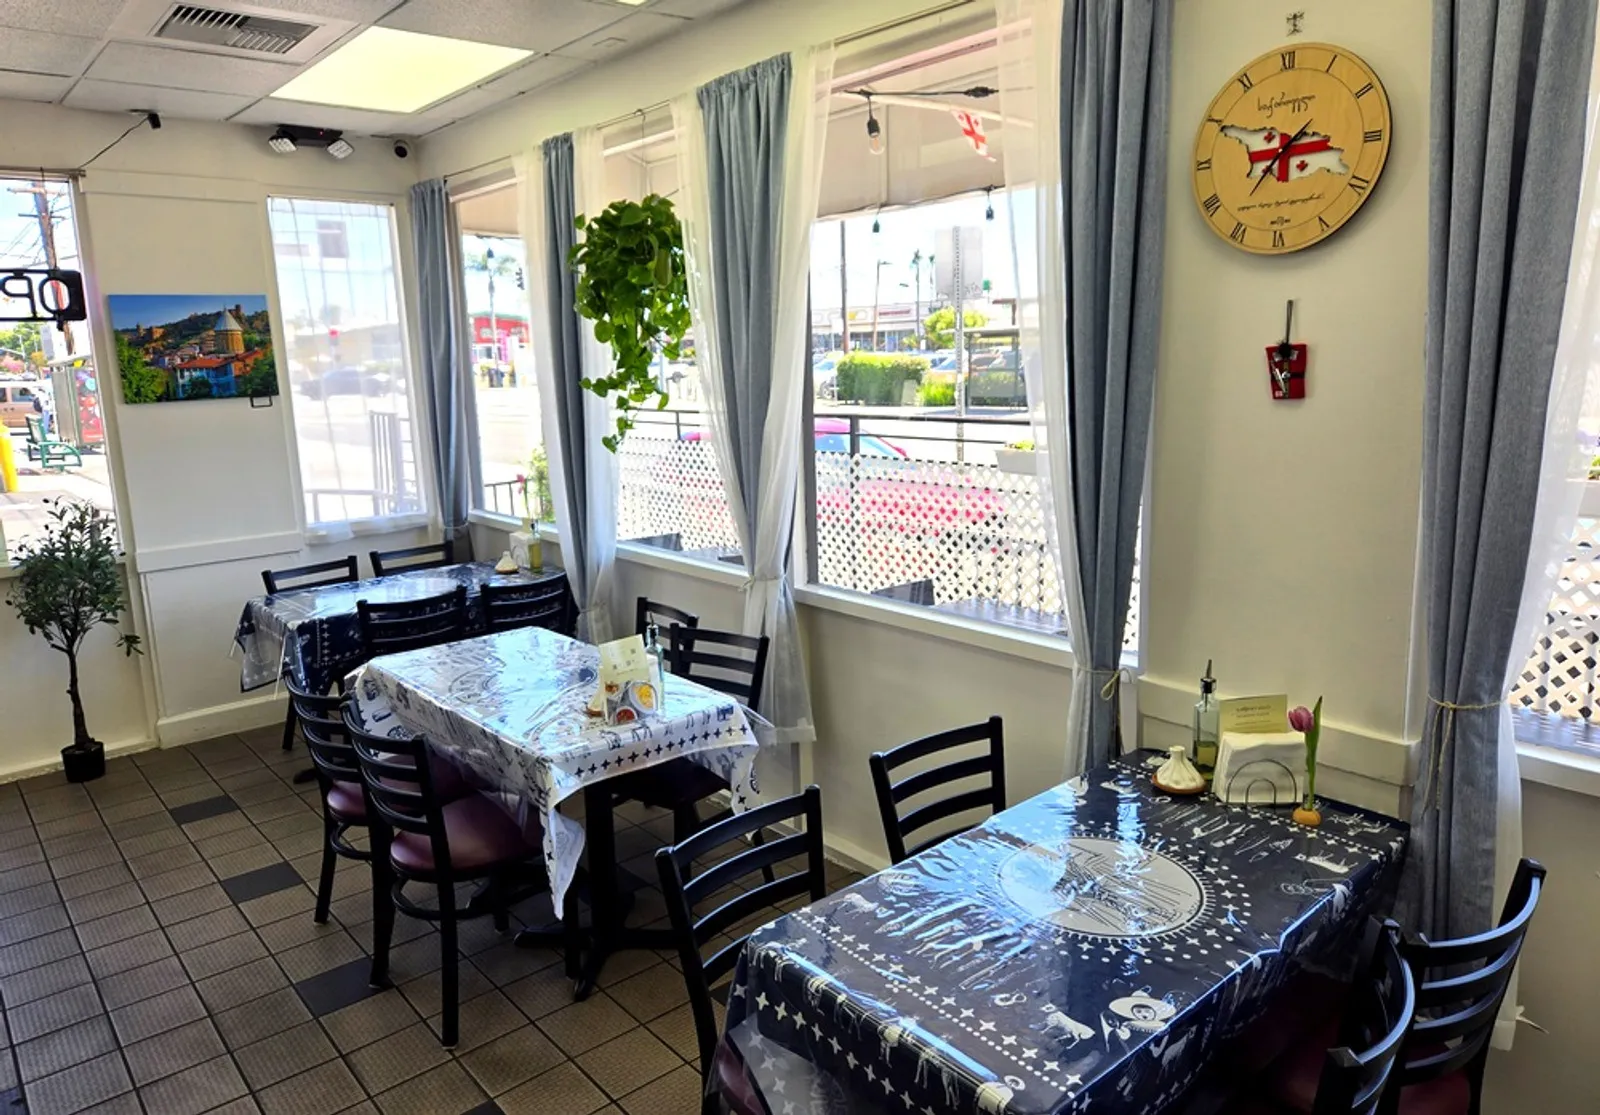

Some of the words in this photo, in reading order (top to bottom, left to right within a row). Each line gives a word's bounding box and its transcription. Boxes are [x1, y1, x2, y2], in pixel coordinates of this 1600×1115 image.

[1280, 51, 1296, 71] XII
[1237, 72, 1253, 93] XI
[1355, 83, 1374, 99] II
[1363, 129, 1382, 143] III
[1196, 158, 1212, 171] IX
[1230, 222, 1247, 243] VII
[1317, 216, 1331, 232] V
[1271, 230, 1285, 248] VI
